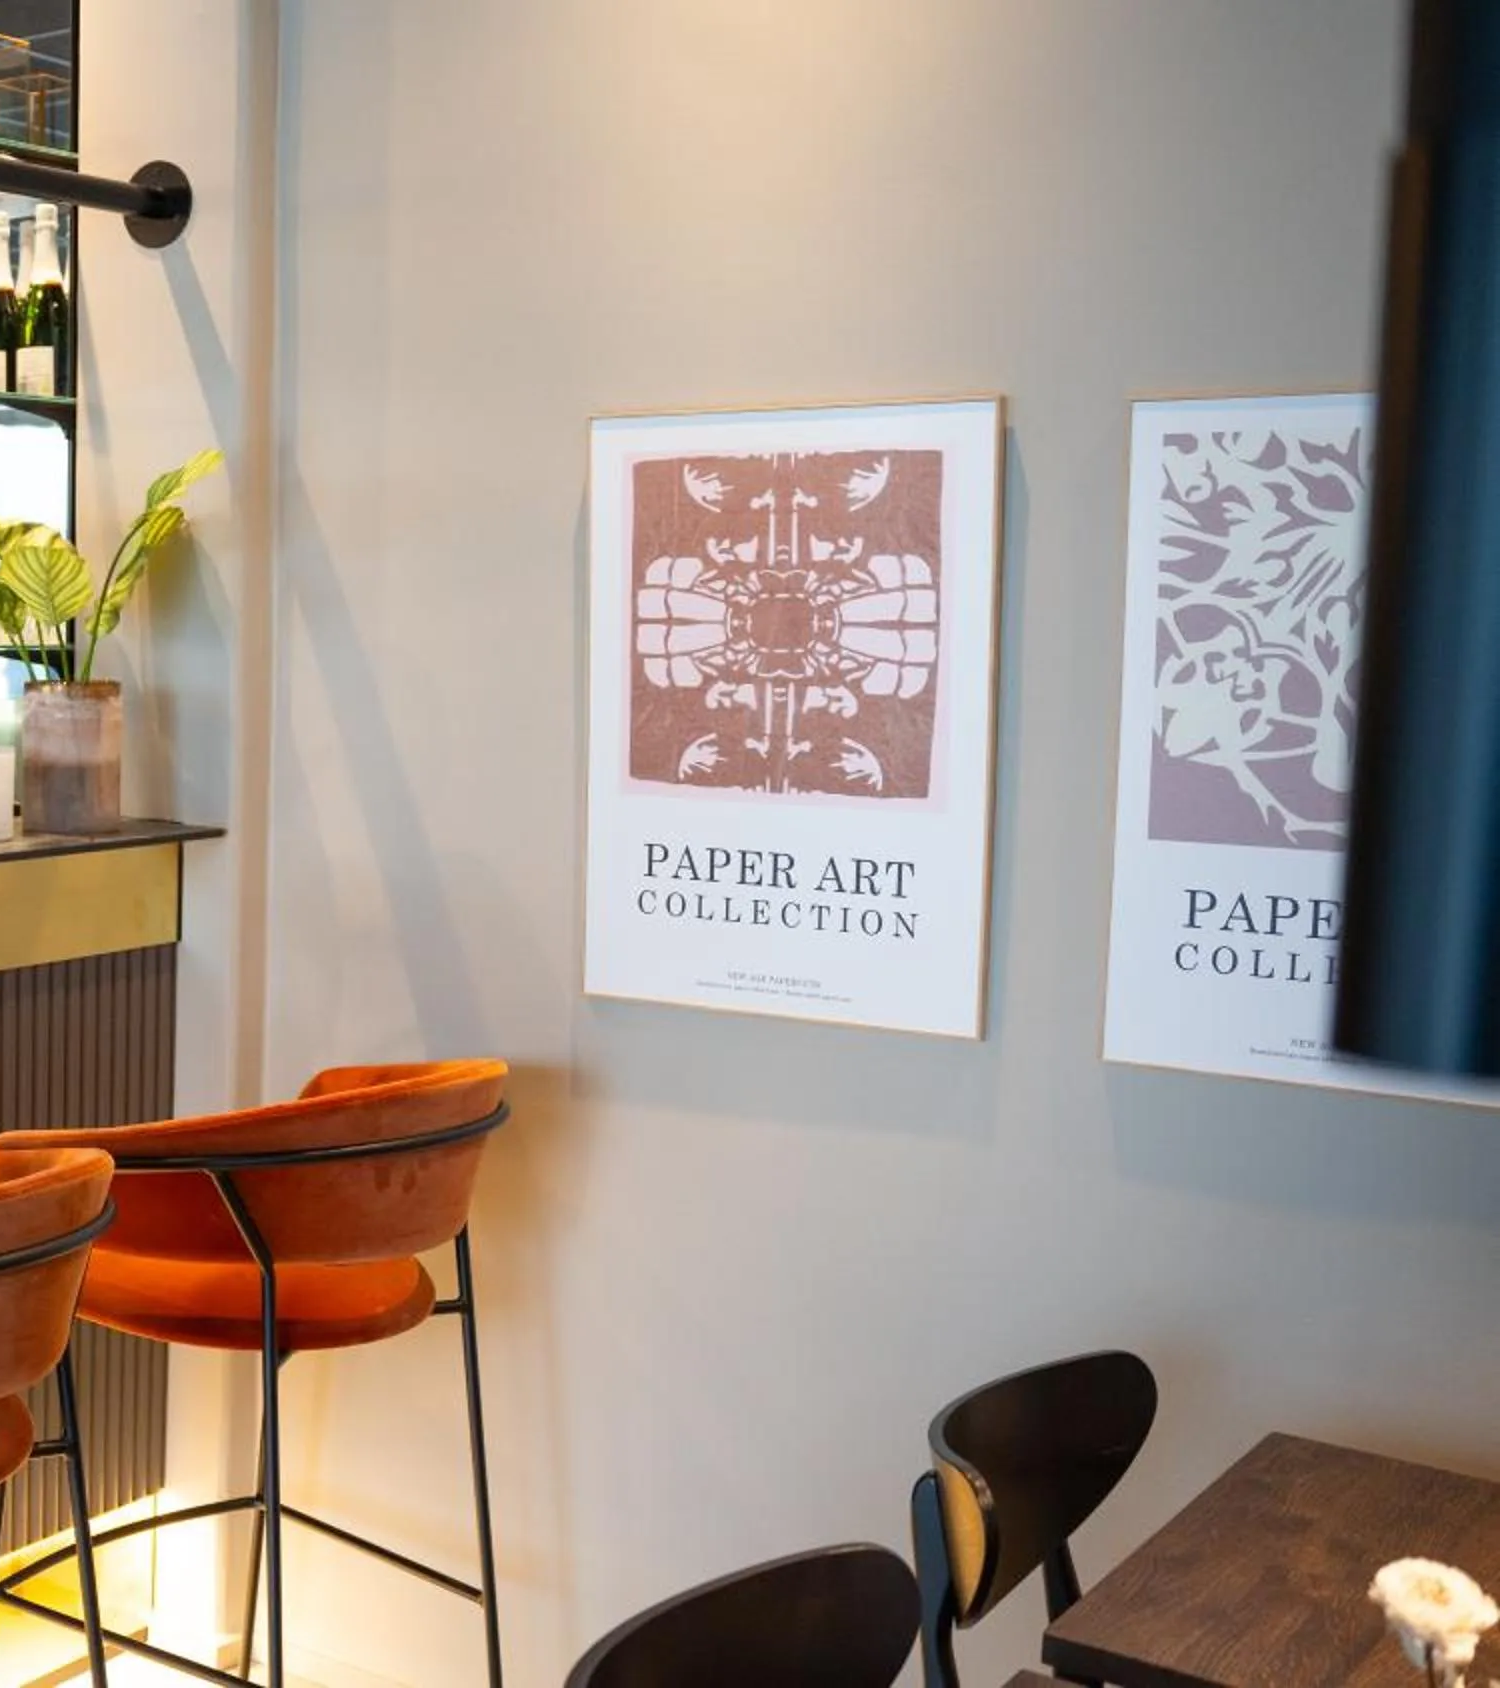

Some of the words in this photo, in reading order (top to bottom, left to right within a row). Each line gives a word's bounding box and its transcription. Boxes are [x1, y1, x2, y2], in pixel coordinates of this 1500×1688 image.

[643, 842, 798, 890] PAPER
[813, 856, 916, 899] ART
[636, 889, 920, 939] COLLECTION
[1182, 888, 1343, 941] PAPE
